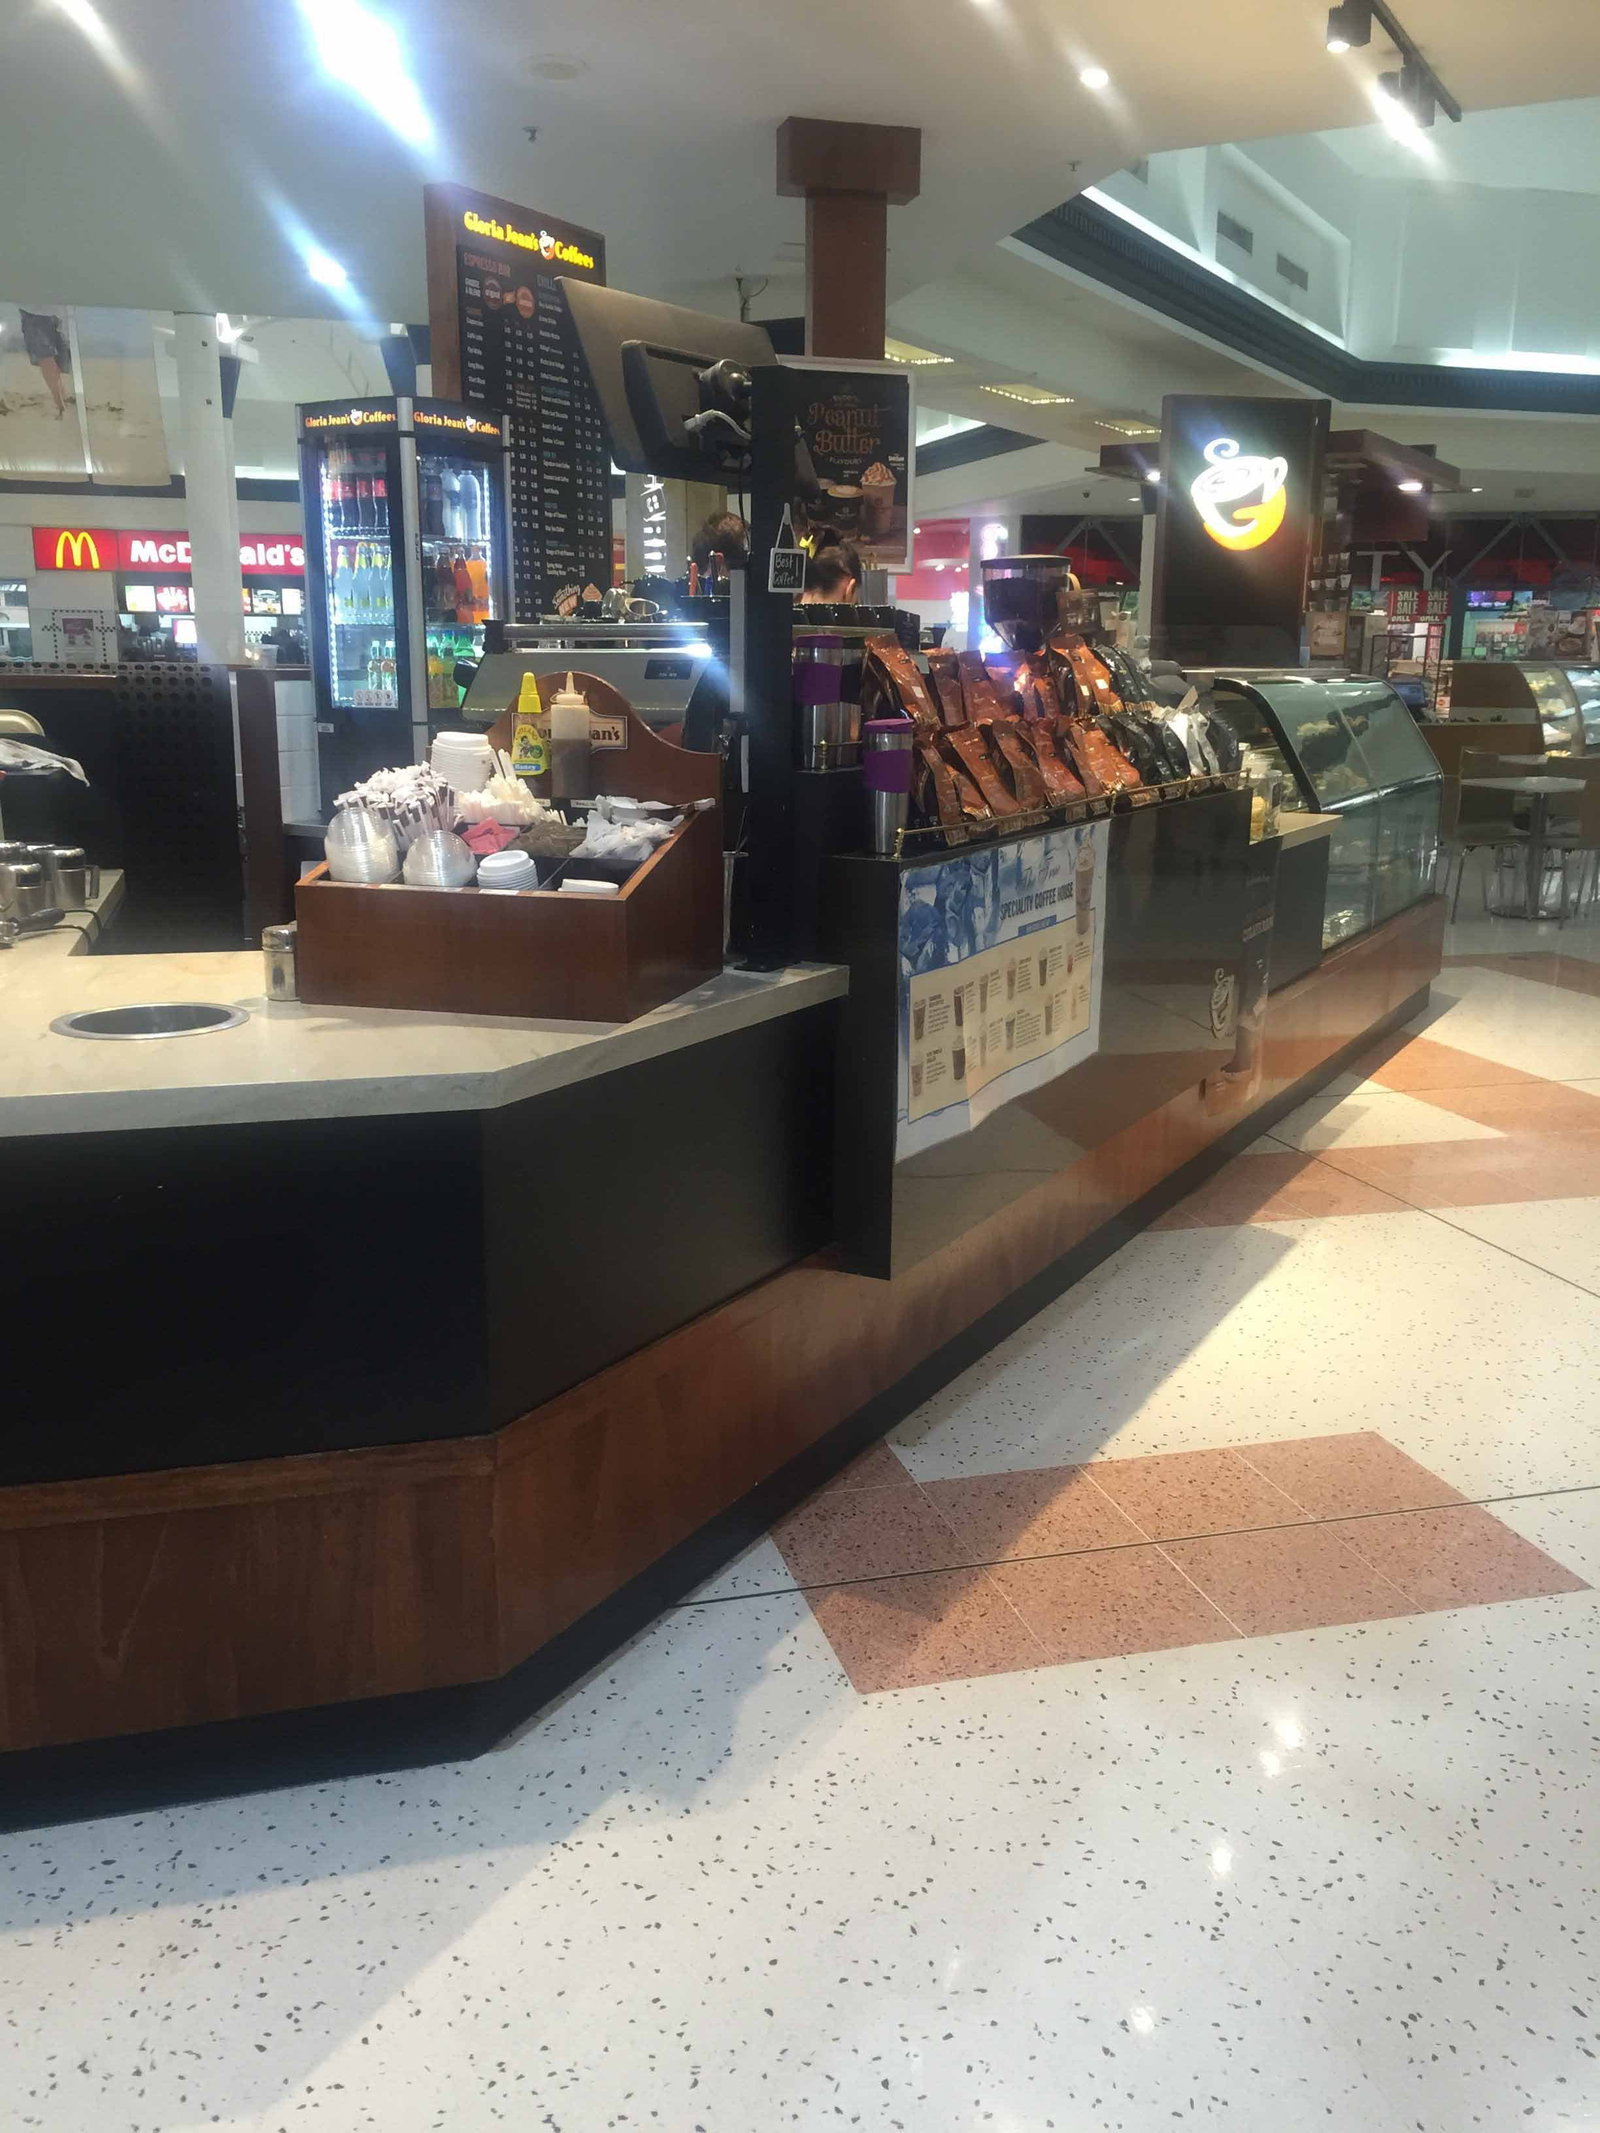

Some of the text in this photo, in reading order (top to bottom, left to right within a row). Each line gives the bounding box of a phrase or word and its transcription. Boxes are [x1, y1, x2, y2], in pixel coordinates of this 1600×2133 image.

[464, 211, 595, 269] Gloria Jean's Coffees
[464, 252, 498, 273] ESPRESSO
[305, 411, 396, 428] Gloria Jean's Coffees
[413, 411, 501, 435] Gloria Jean's Coffees
[808, 402, 888, 428] Peanut
[813, 428, 880, 455] Butter
[130, 540, 305, 567] McDald's
[775, 553, 793, 569] Best
[1397, 601, 1419, 614] SALE
[1427, 601, 1448, 614] SALE
[591, 726, 620, 741] an's
[1034, 887, 1057, 909] COFFEE
[1057, 881, 1074, 902] HOUSE
